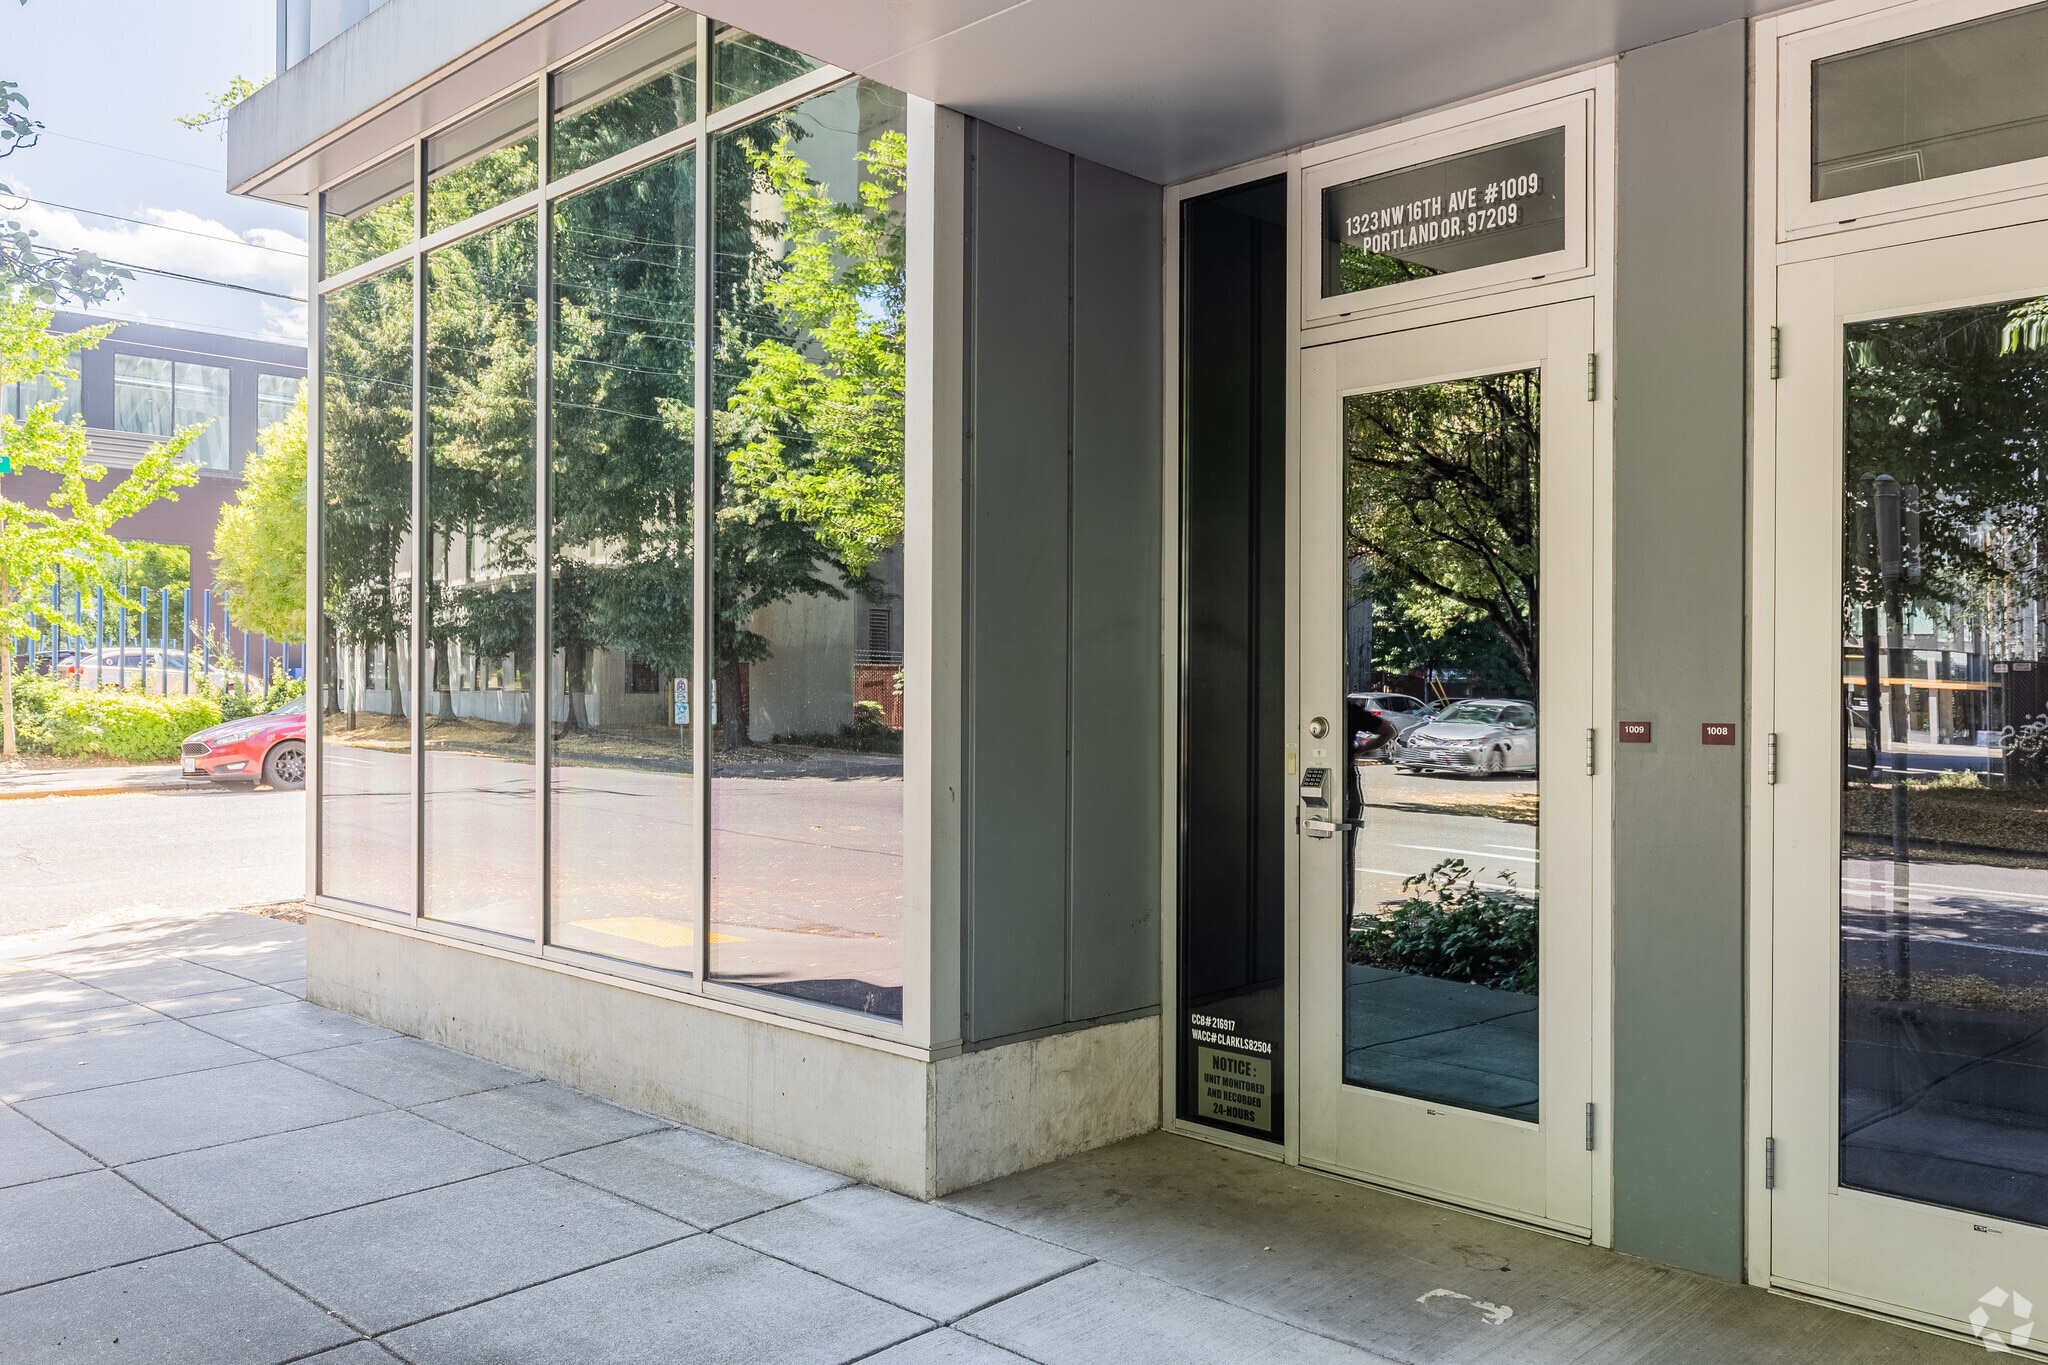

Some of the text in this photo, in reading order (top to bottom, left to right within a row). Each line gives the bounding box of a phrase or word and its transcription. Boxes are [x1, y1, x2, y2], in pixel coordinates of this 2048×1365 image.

[1346, 172, 1538, 236] 1323 NW 16TH AVE #1009
[1363, 221, 1439, 255] PORTLAND
[1467, 203, 1518, 233] 97209
[1624, 725, 1645, 734] 1009
[1706, 727, 1728, 736] 1008
[1212, 1017, 1235, 1031] 216917
[1204, 1073, 1265, 1095] UNIT MONITORED
[1207, 1087, 1262, 1108] AND RECORDED
[1213, 1102, 1256, 1123] 24-HOURS
